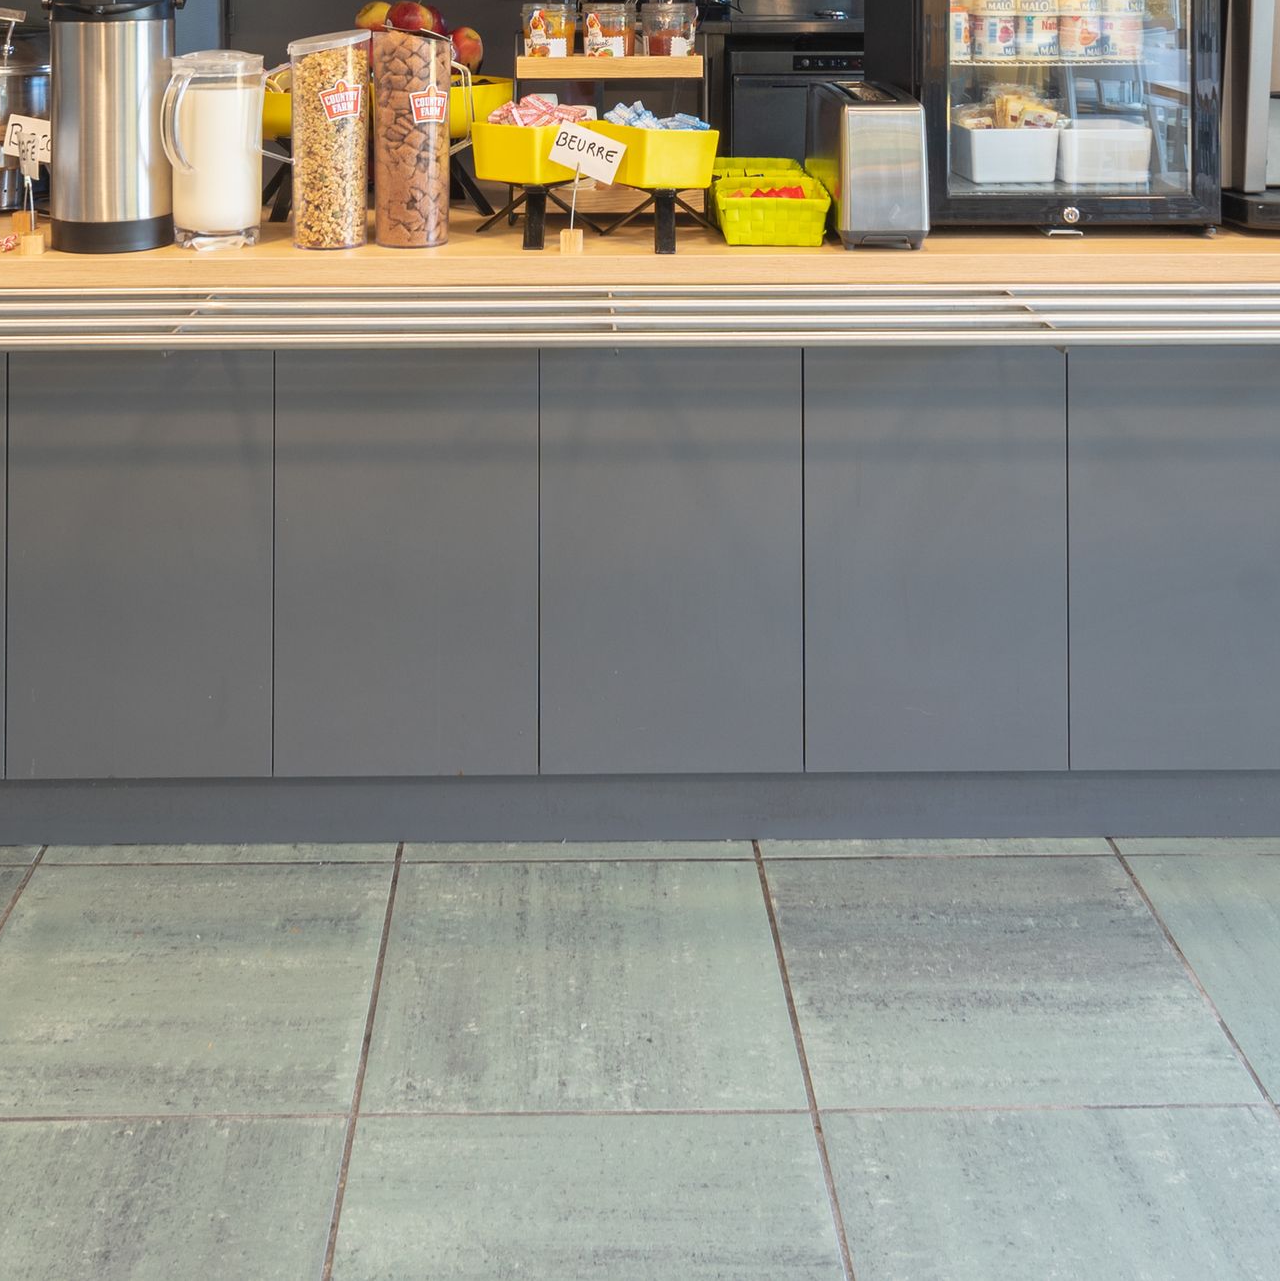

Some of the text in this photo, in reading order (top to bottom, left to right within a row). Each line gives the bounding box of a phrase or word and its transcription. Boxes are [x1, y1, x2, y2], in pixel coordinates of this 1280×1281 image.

[987, 0, 1012, 12] MALO
[1021, 0, 1050, 12] MALO
[324, 90, 359, 106] COUNTRY
[331, 101, 354, 114] FARM
[420, 106, 441, 117] FARM
[555, 131, 618, 164] BEURRE
